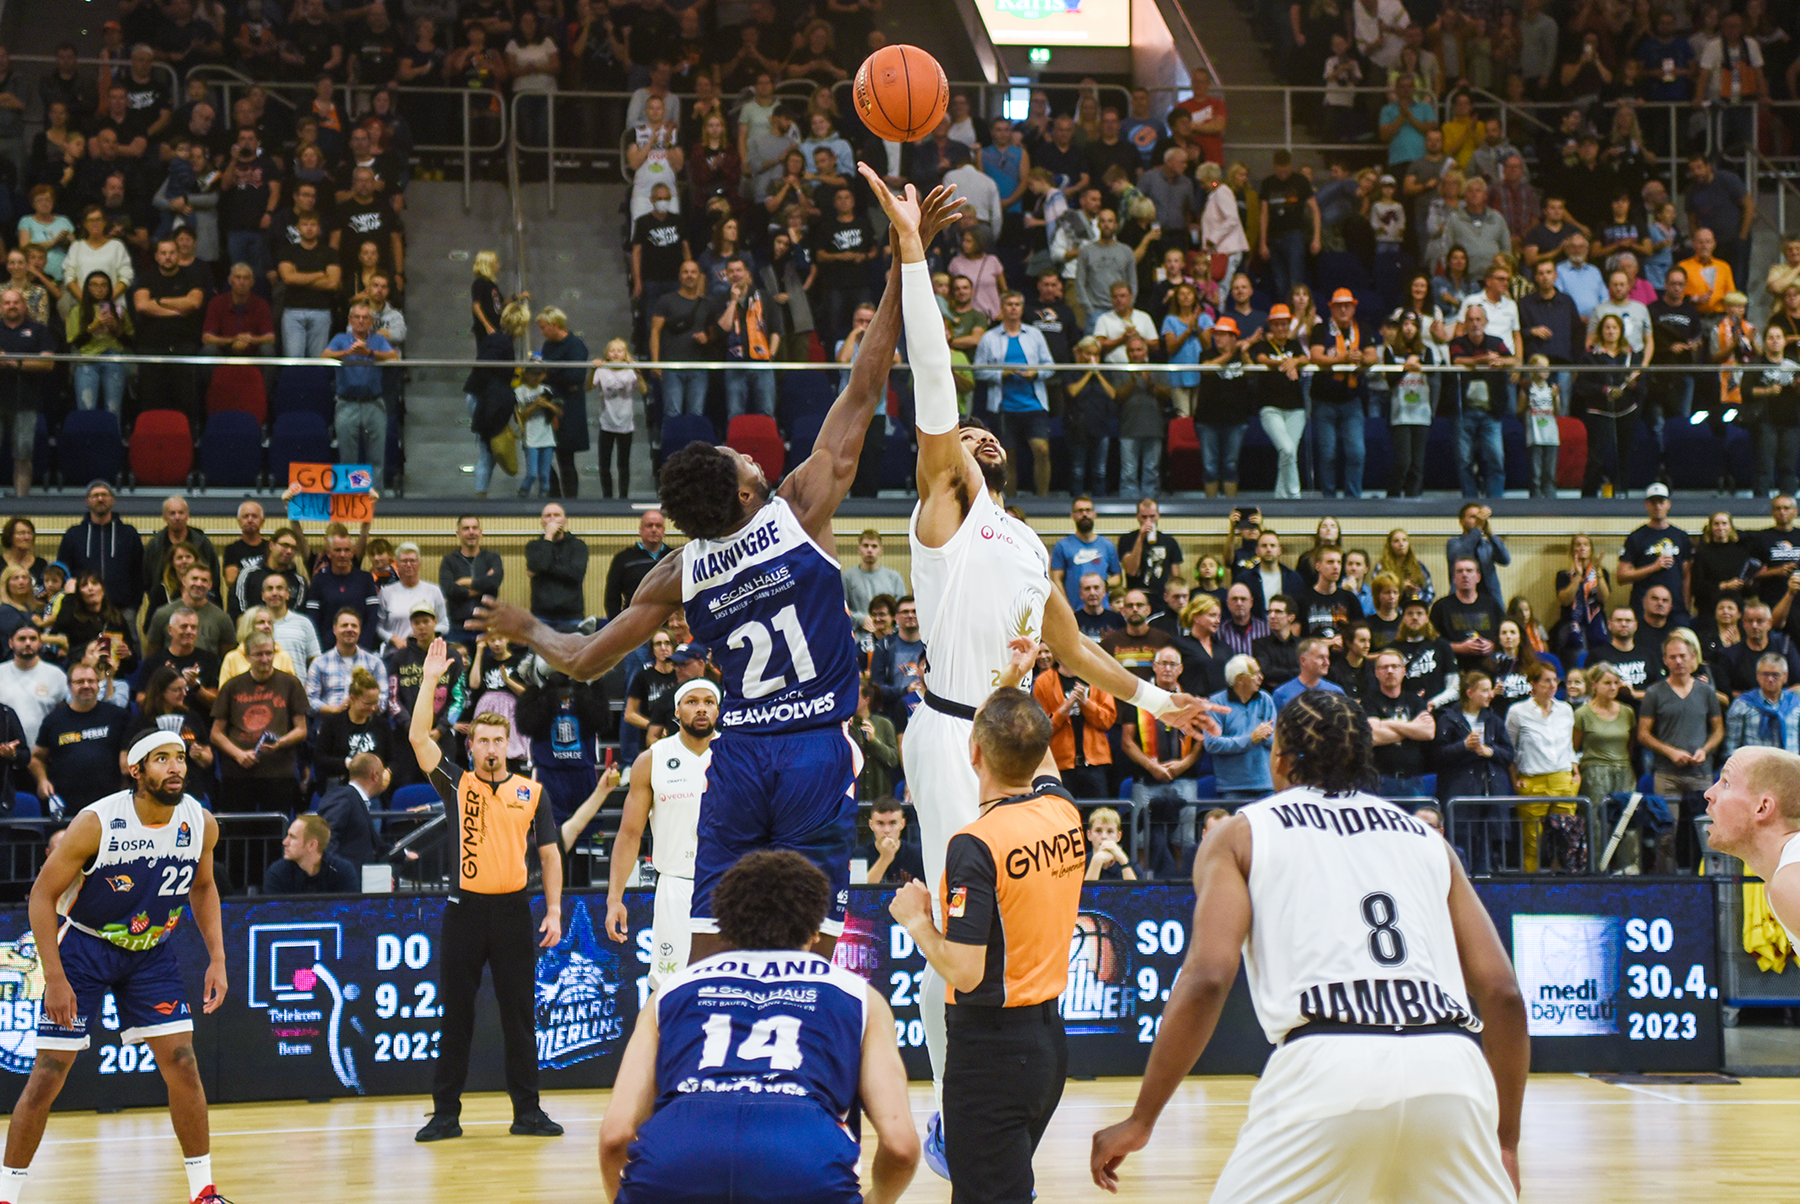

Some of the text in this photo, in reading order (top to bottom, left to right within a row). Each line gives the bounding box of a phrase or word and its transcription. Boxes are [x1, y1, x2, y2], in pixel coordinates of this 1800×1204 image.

[720, 566, 791, 604] SCAN HAUS
[771, 579, 796, 597] ZAHLEN
[726, 603, 817, 699] 21
[722, 691, 836, 727] SEAWOLVES
[667, 792, 695, 800] VEOLIA
[121, 839, 155, 852] OSPA
[461, 789, 480, 879] GYMPER
[684, 850, 695, 859] 28
[1005, 826, 1084, 880] GYMPE
[157, 864, 194, 897] 22
[1135, 919, 1186, 956] SO
[1359, 891, 1409, 968] 8
[1624, 917, 1675, 954] SO
[375, 932, 432, 972] DO
[718, 986, 818, 1002] SCAN HAUS
[1540, 978, 1598, 1001] medi
[1626, 963, 1720, 1000] 30.4.
[697, 1012, 804, 1071] 14
[1627, 1011, 1698, 1041] 2023
[98, 1042, 157, 1075] 202
